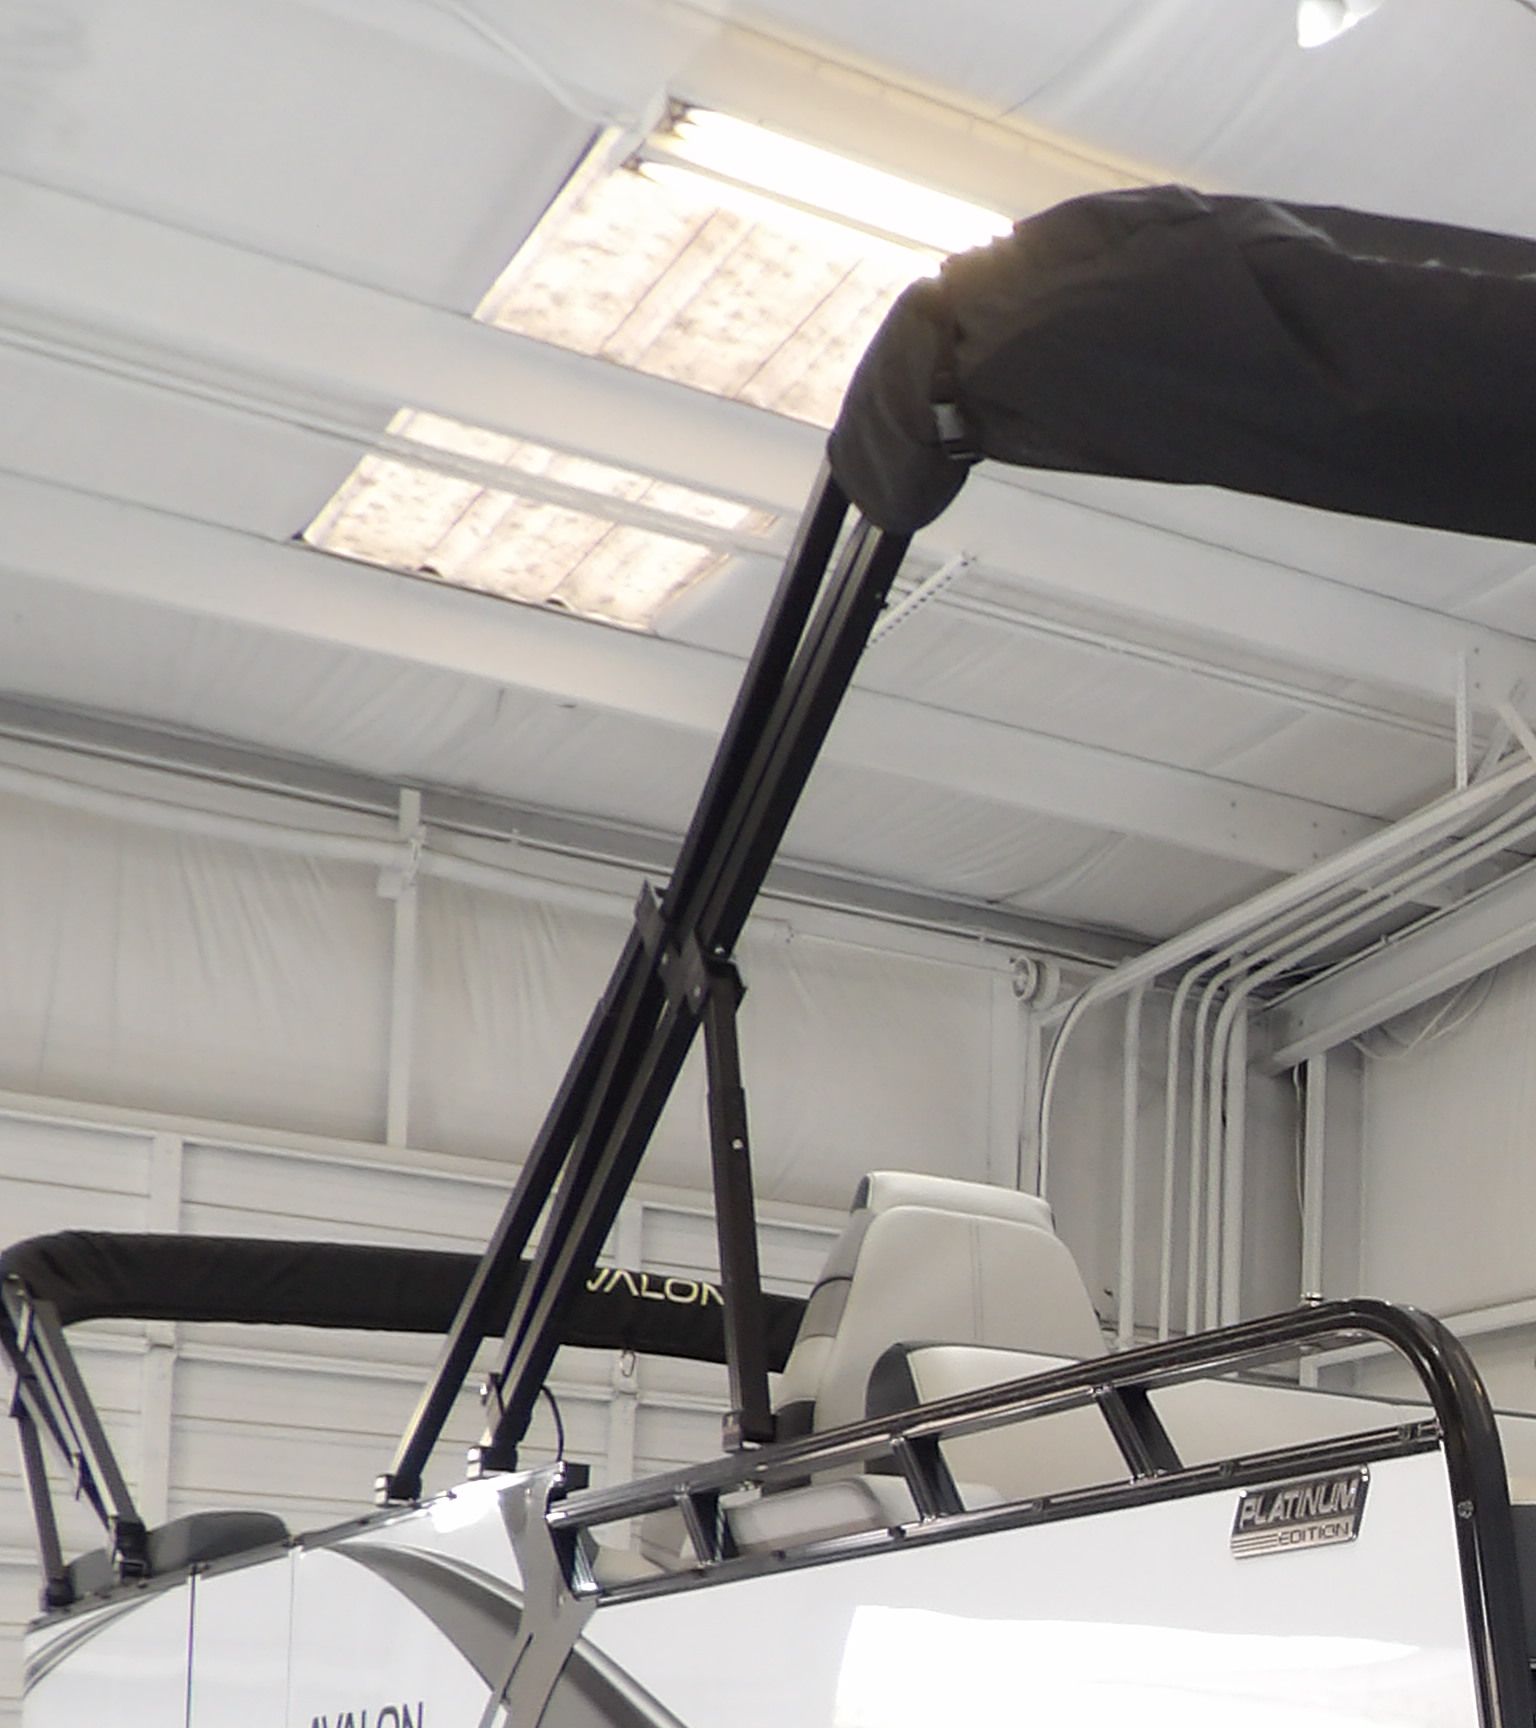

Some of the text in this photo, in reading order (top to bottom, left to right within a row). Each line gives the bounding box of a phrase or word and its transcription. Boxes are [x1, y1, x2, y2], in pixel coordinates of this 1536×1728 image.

[586, 1268, 725, 1306] VALON
[1239, 1478, 1360, 1529] PLATINUM
[1278, 1522, 1350, 1546] EDITION
